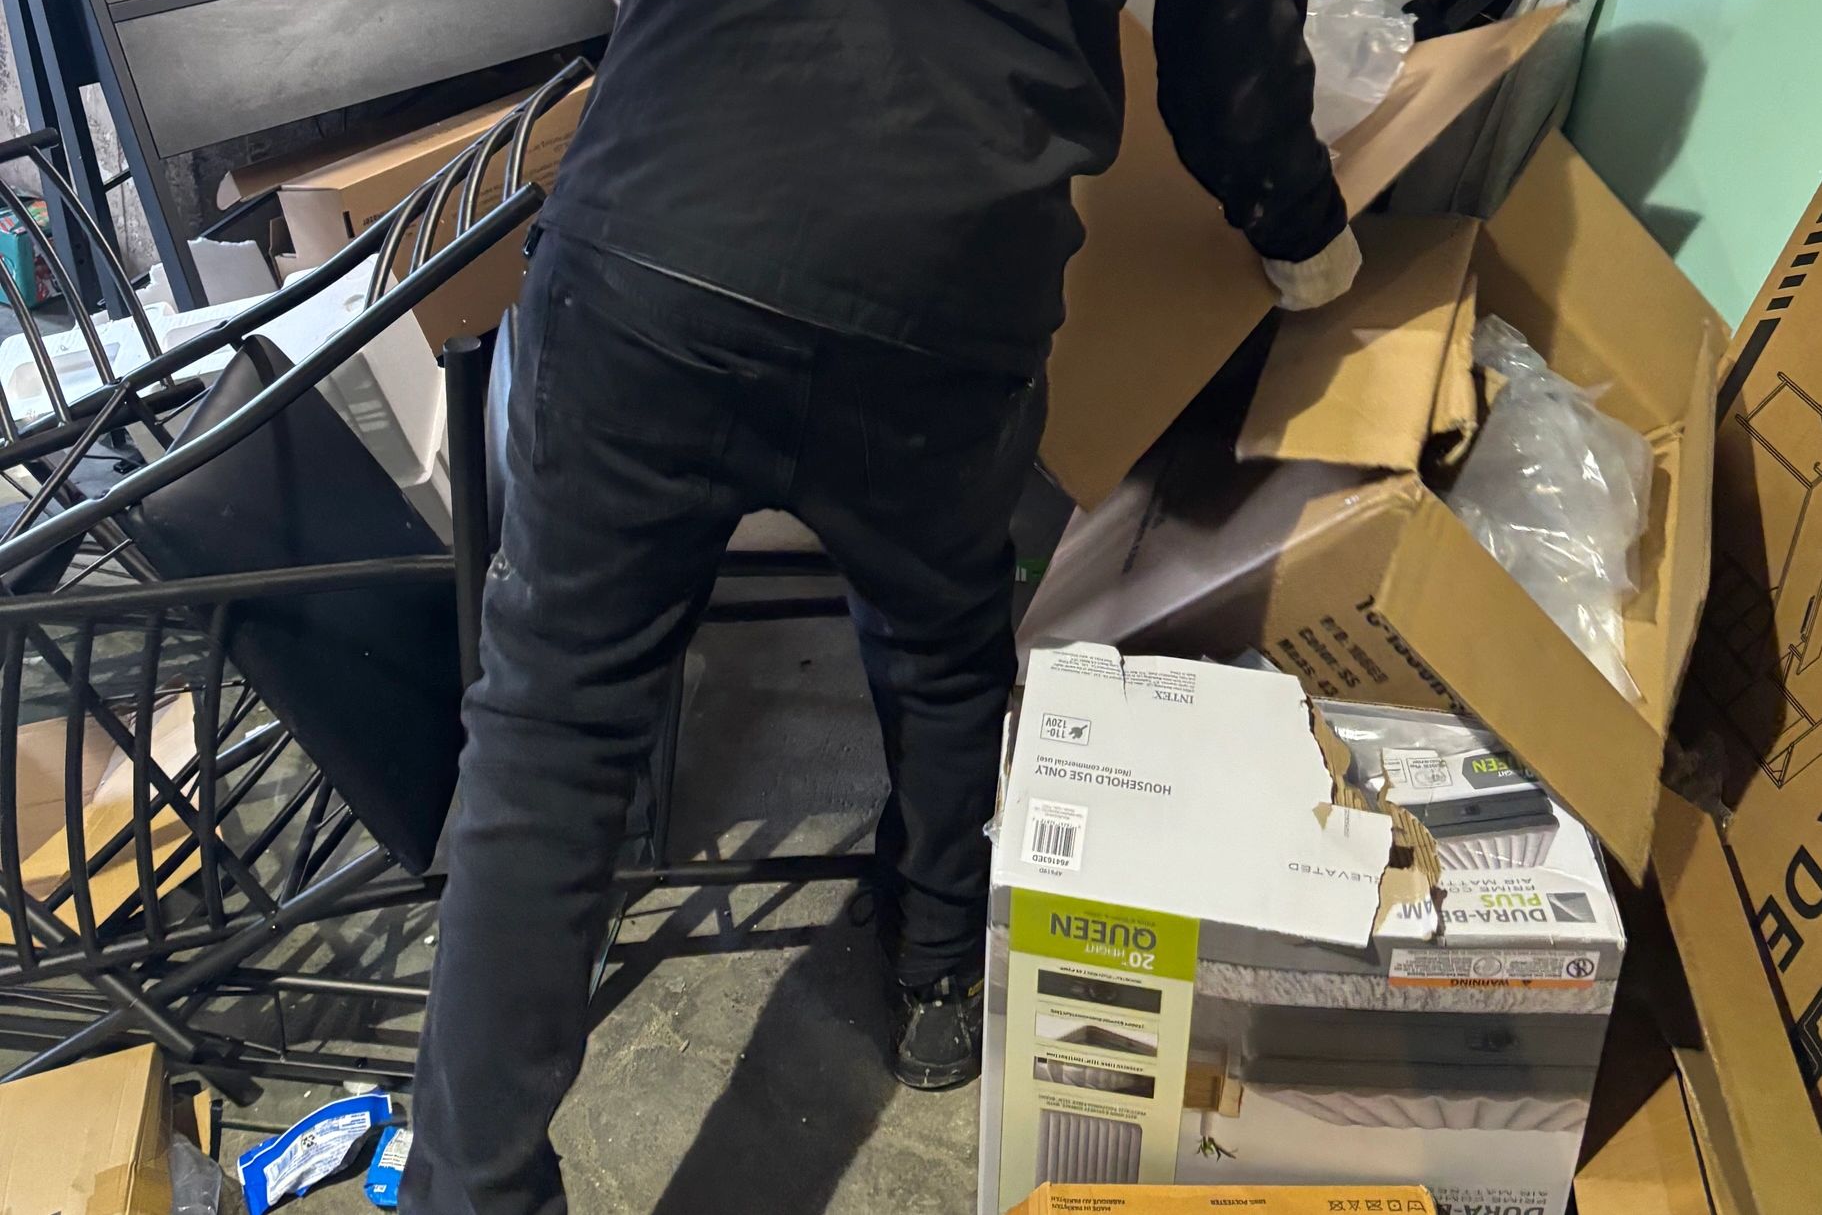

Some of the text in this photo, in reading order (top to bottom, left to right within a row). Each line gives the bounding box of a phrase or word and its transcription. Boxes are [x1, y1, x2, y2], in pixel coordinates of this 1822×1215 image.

[1153, 690, 1194, 704] INTEX
[1045, 717, 1067, 728] 120V
[1047, 728, 1065, 738] 110-
[1037, 755, 1132, 777] (Not for commercial use)
[1035, 765, 1172, 795] HOUSEHOLD USE ONLY
[1506, 877, 1533, 885] AIR
[1493, 885, 1536, 893] PRIME
[1480, 893, 1542, 908] PLUS
[1050, 912, 1157, 951] QUEEN
[1084, 942, 1125, 959] HEIGHT
[1450, 978, 1510, 987] WARNING
